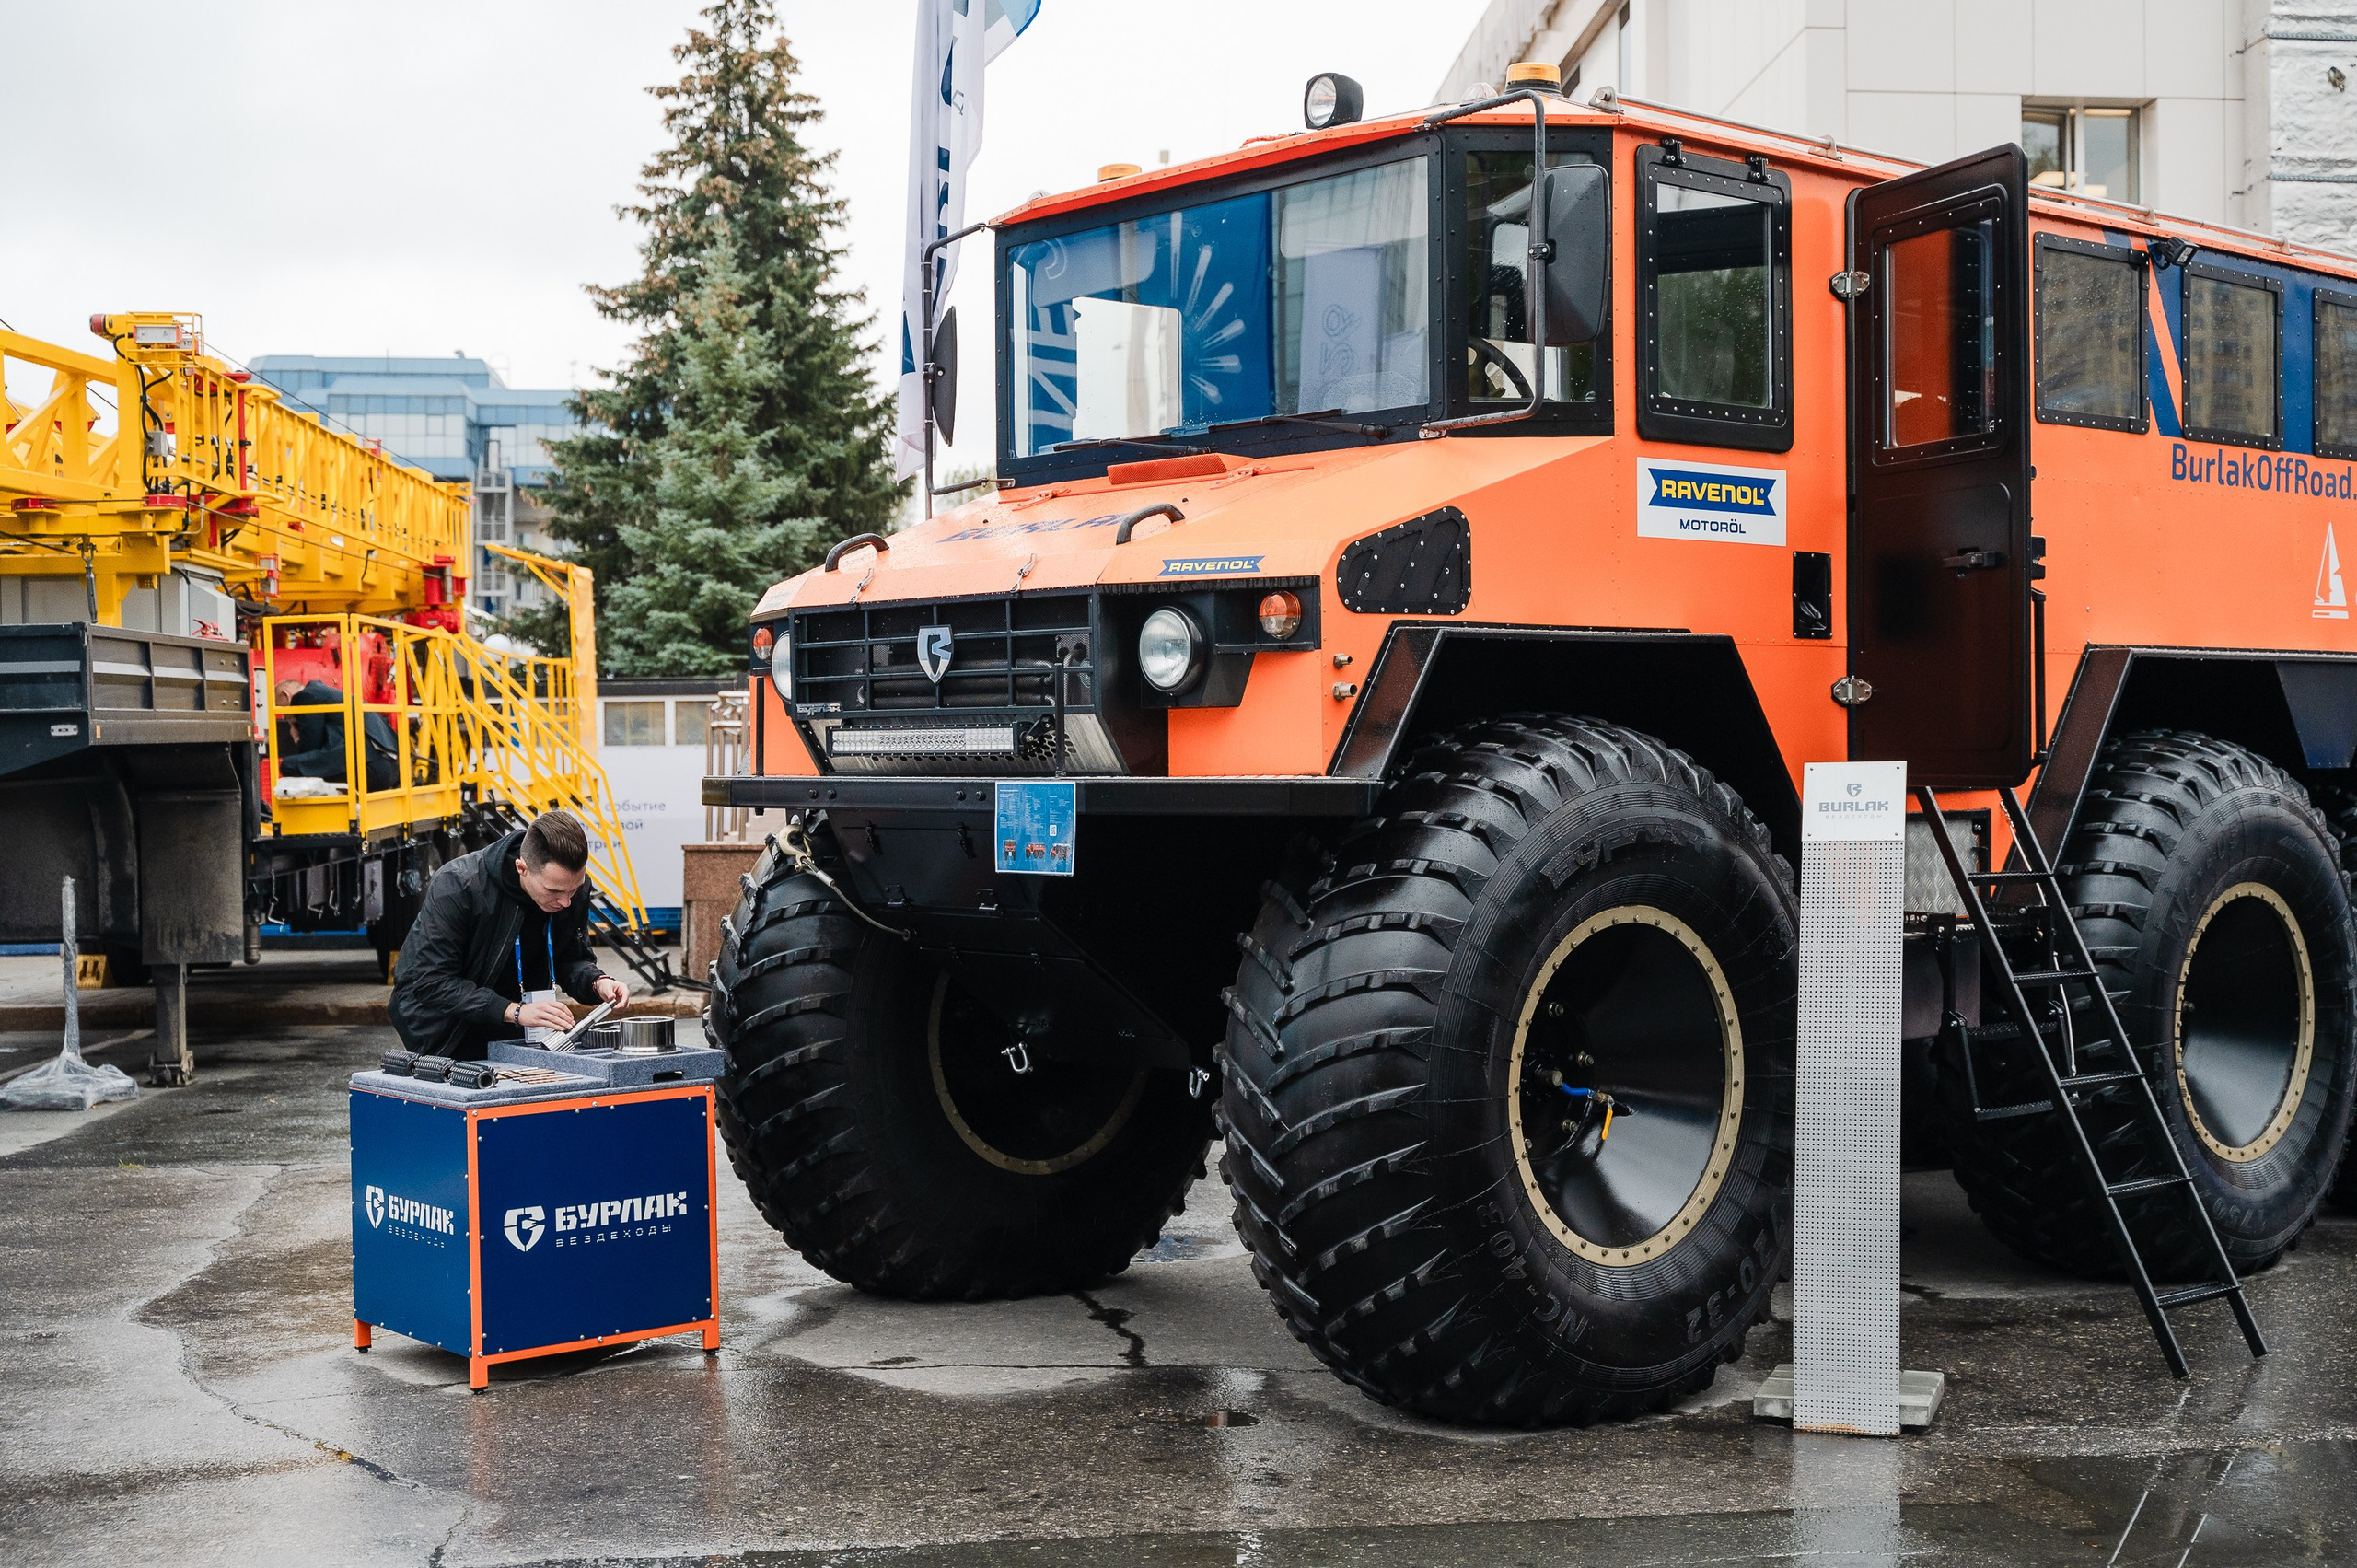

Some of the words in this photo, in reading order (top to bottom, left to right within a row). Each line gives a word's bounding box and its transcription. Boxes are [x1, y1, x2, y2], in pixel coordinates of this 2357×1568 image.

[1661, 479, 1765, 505] RAVENOL
[1679, 518, 1747, 534] MOTORÖL
[1168, 560, 1254, 573] RAVENOL
[1818, 801, 1889, 812] BURLAK
[388, 1194, 454, 1236] БУРЛАК
[555, 1191, 688, 1232] БУРЛАК
[555, 1224, 672, 1248] ВЕЗДЕХОДЫ
[1477, 1200, 1589, 1345] NC-403
